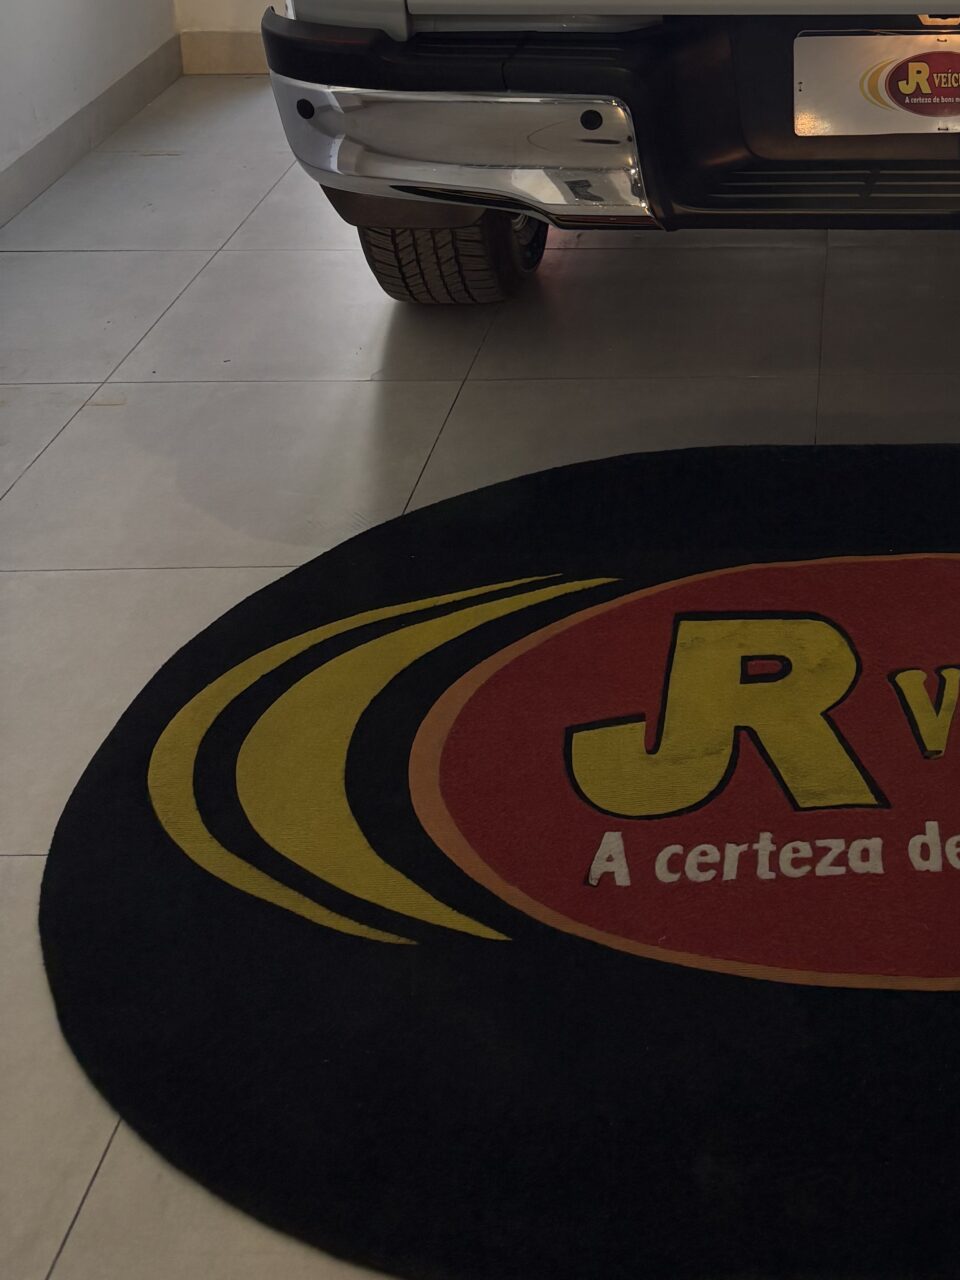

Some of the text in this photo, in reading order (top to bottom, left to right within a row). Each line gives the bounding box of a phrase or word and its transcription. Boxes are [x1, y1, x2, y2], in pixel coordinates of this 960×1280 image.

[898, 62, 932, 95] JR
[905, 96, 910, 104] A
[566, 614, 889, 820] JR
[587, 831, 631, 887] A
[654, 831, 885, 884] certeza
